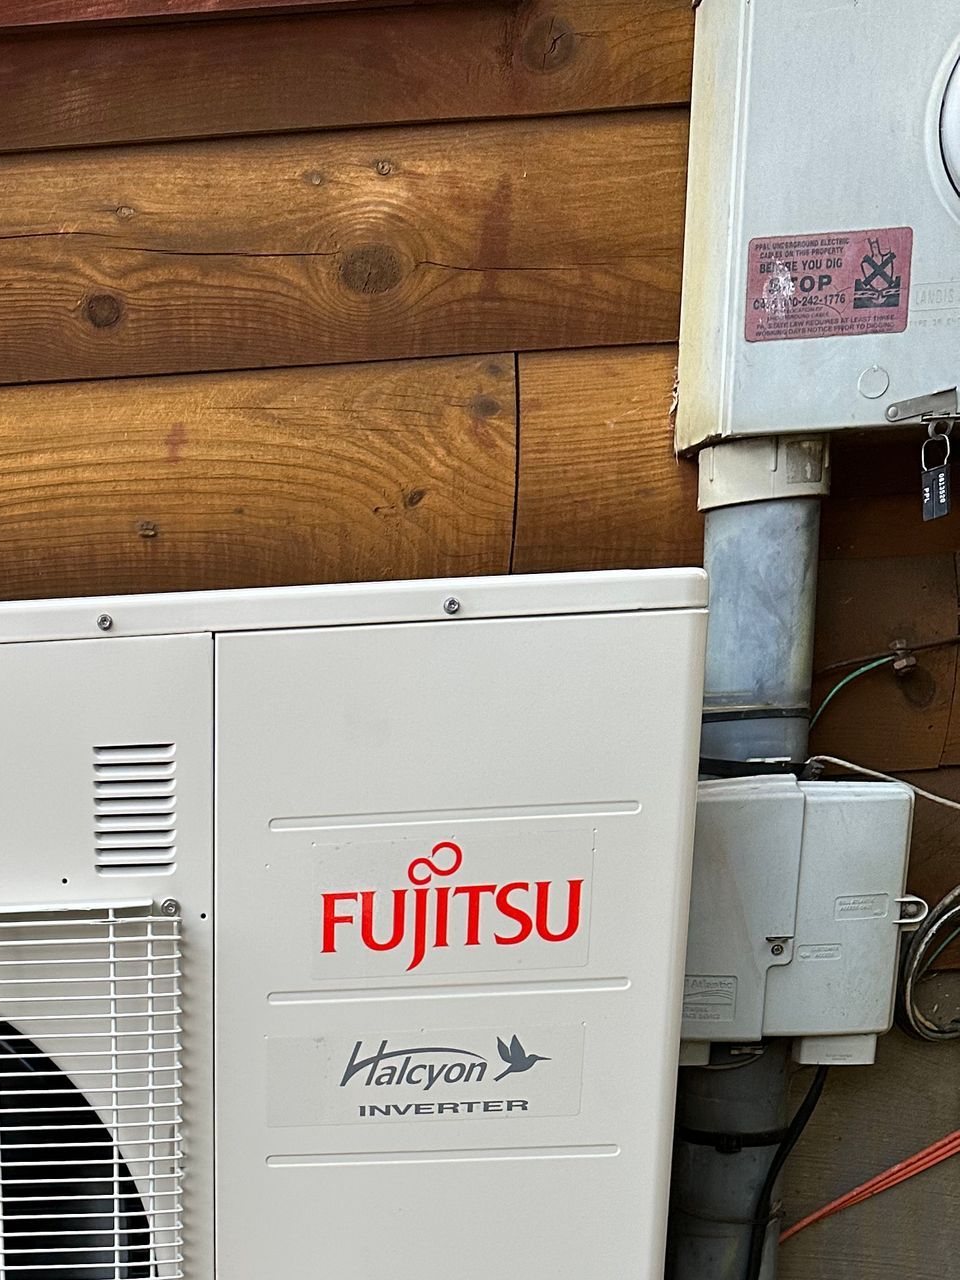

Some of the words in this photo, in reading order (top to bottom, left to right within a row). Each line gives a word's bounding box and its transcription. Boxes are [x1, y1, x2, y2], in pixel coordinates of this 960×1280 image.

[811, 246, 844, 256] PROPERTY
[802, 259, 822, 271] YOU
[825, 257, 843, 269] DIG
[789, 319, 804, 328] LAW
[320, 841, 585, 972] FUJITSU
[340, 1040, 488, 1091] Halcyon
[359, 1099, 529, 1117] INVERTER
